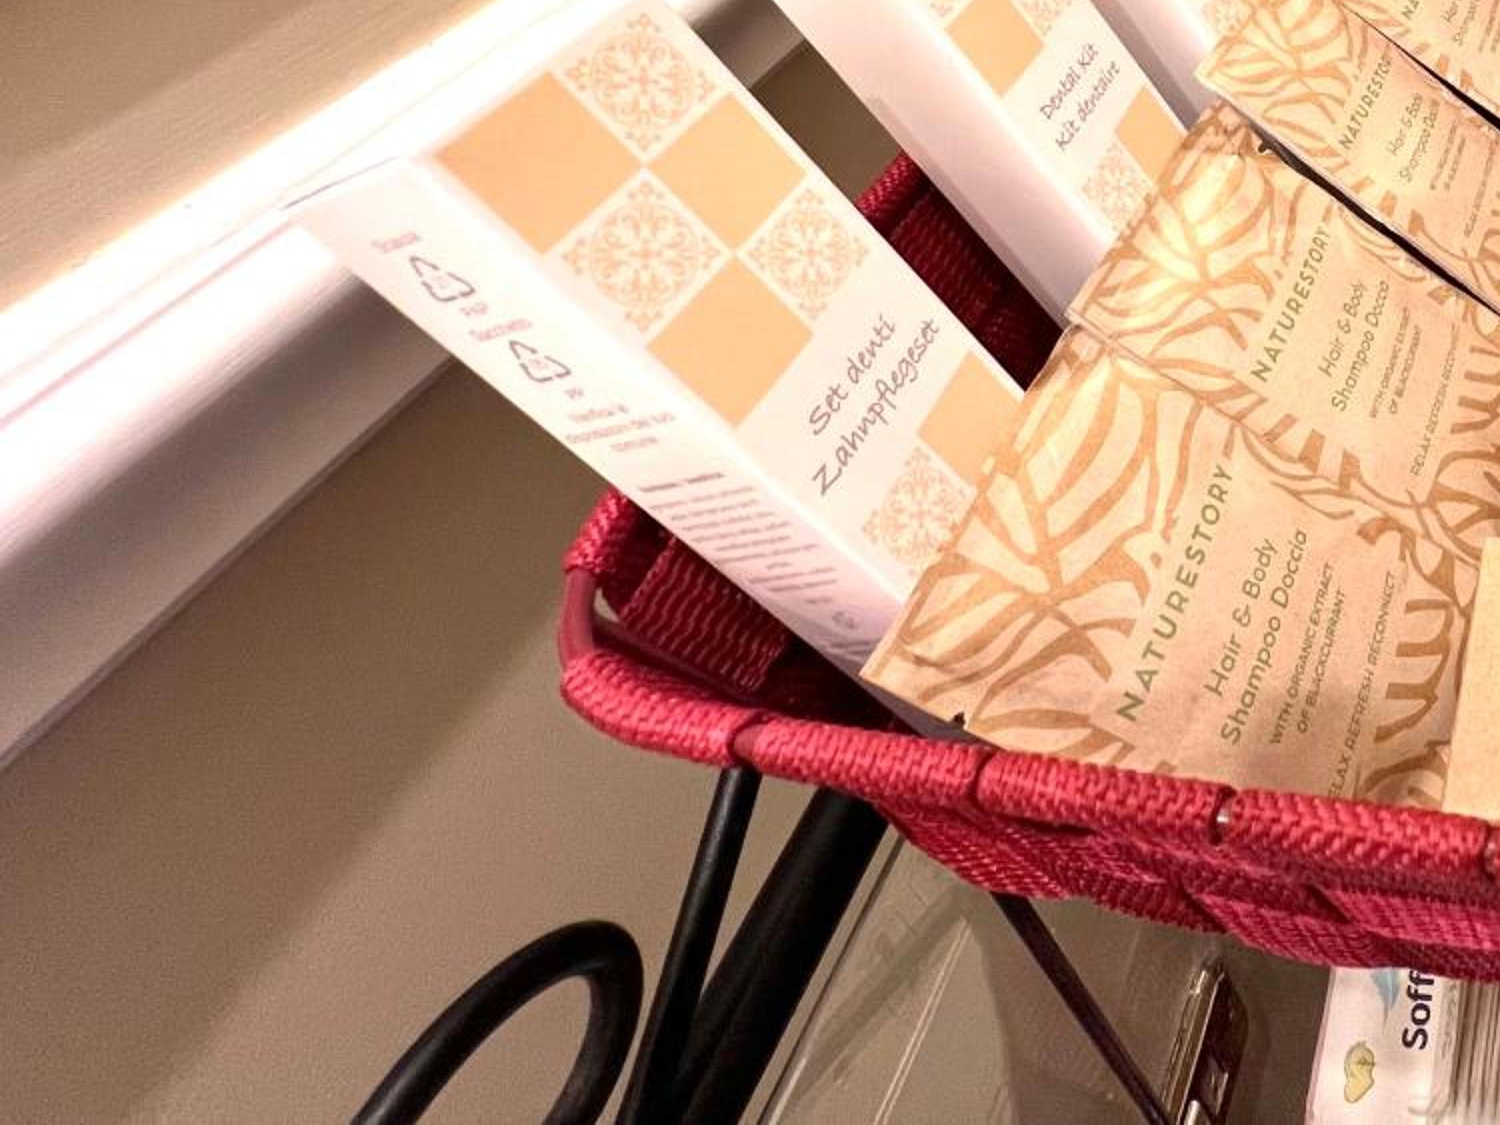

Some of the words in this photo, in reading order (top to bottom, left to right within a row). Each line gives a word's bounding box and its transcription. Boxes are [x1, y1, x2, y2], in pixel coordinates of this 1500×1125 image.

[1039, 66, 1081, 120] Dental
[1077, 60, 1120, 123] dentaire
[1250, 225, 1331, 383] NATURESTORY
[1337, 317, 1352, 335] &
[1342, 278, 1368, 319] Body
[809, 382, 849, 436] Set
[847, 311, 896, 385] denti
[1317, 336, 1345, 378] Hair
[1330, 329, 1376, 412] Shampoo
[811, 319, 940, 497] Zahnpflegeset
[1115, 464, 1233, 723] NATURESTORY
[1241, 537, 1280, 601] Body
[1219, 615, 1282, 746] Shampoo
[1270, 529, 1308, 610] Doccia
[1231, 606, 1252, 629] &
[1269, 701, 1295, 745] WITH
[1287, 626, 1316, 699] ORGANIC
[1310, 562, 1336, 627] EXTRACT
[1203, 633, 1243, 698] Hair
[1296, 704, 1312, 735] OF
[1305, 589, 1346, 708] BLACKCURRANT
[1328, 753, 1352, 797] ELAX
[1344, 665, 1376, 751] REFRESH
[1366, 570, 1403, 666] RECONNECT
